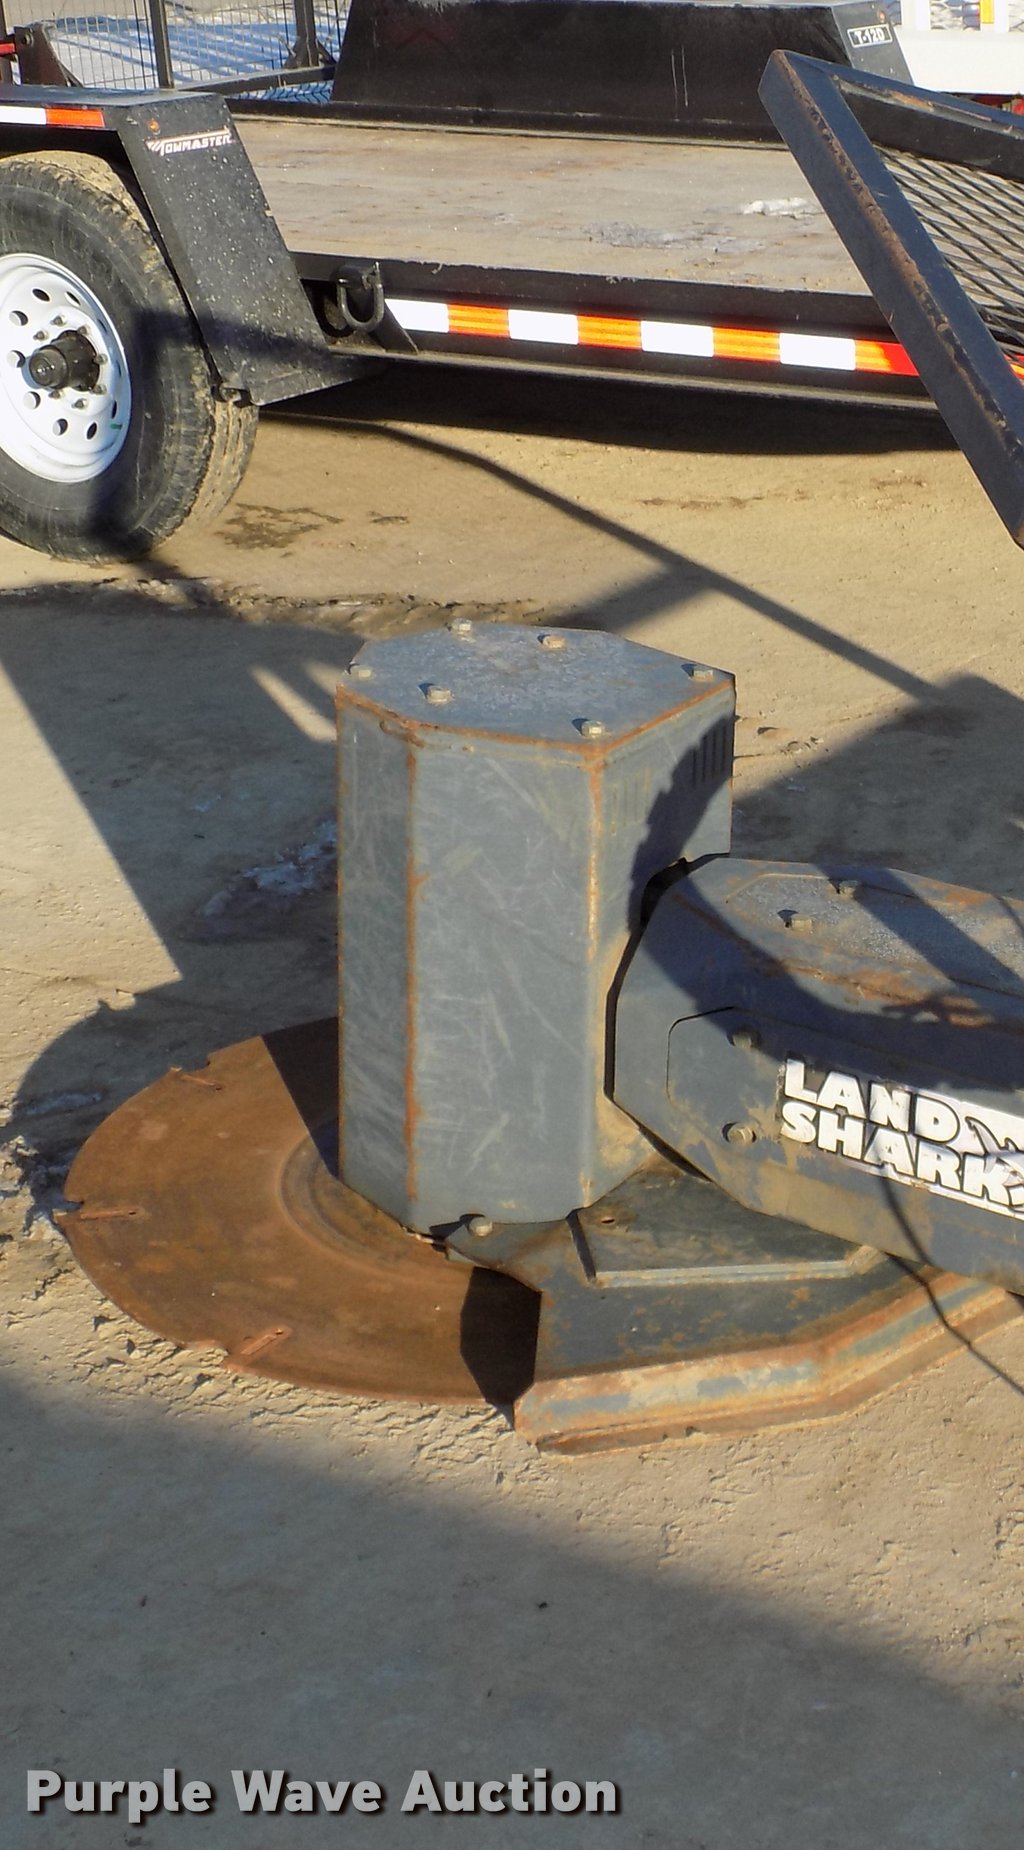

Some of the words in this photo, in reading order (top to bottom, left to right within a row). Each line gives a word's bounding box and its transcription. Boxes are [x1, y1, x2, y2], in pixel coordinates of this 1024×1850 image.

[145, 126, 233, 156] TOWMASTER
[783, 1058, 961, 1143] LAND
[780, 1101, 1014, 1206] SHARK
